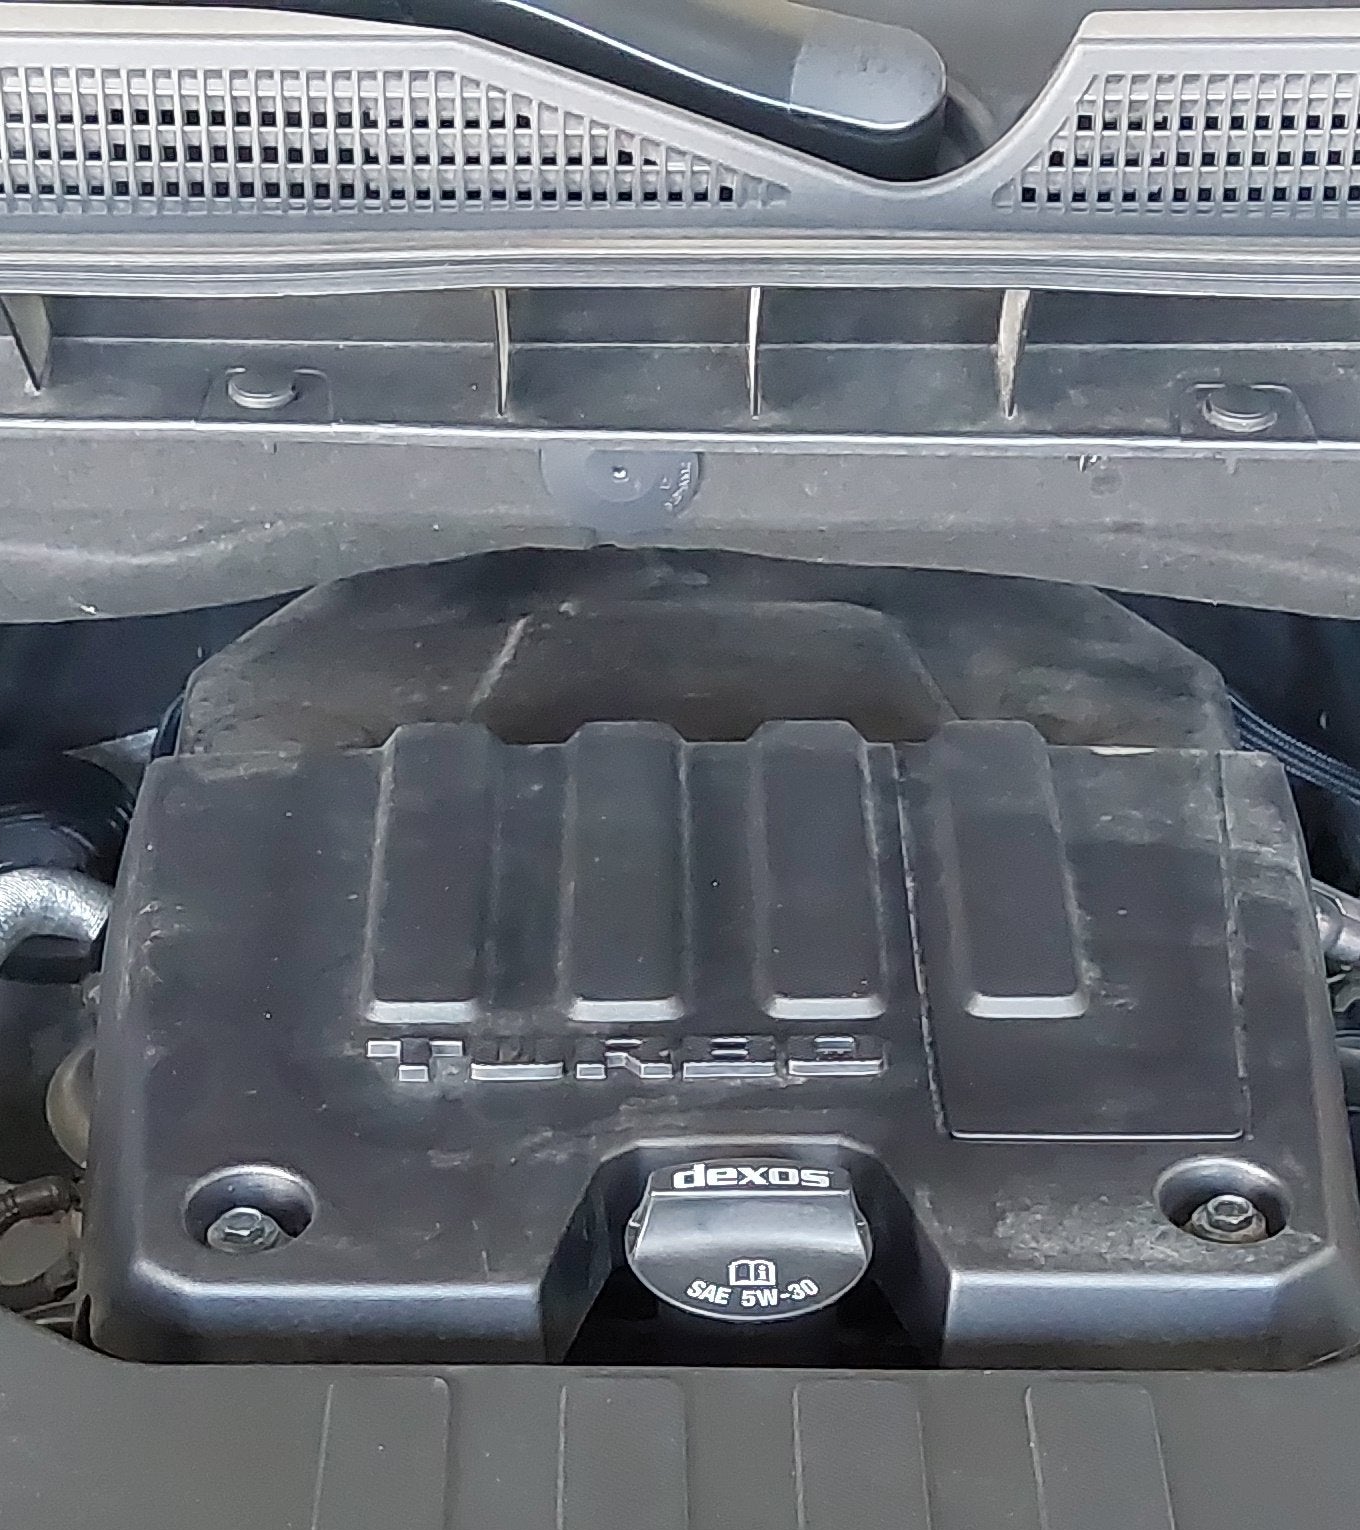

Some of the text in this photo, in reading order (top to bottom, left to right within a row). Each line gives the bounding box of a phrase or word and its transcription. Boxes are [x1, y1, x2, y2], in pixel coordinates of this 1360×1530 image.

[366, 1036, 887, 1083] TURBO
[673, 1163, 830, 1189] dexos
[687, 1279, 819, 1307] SAE 5W-30
